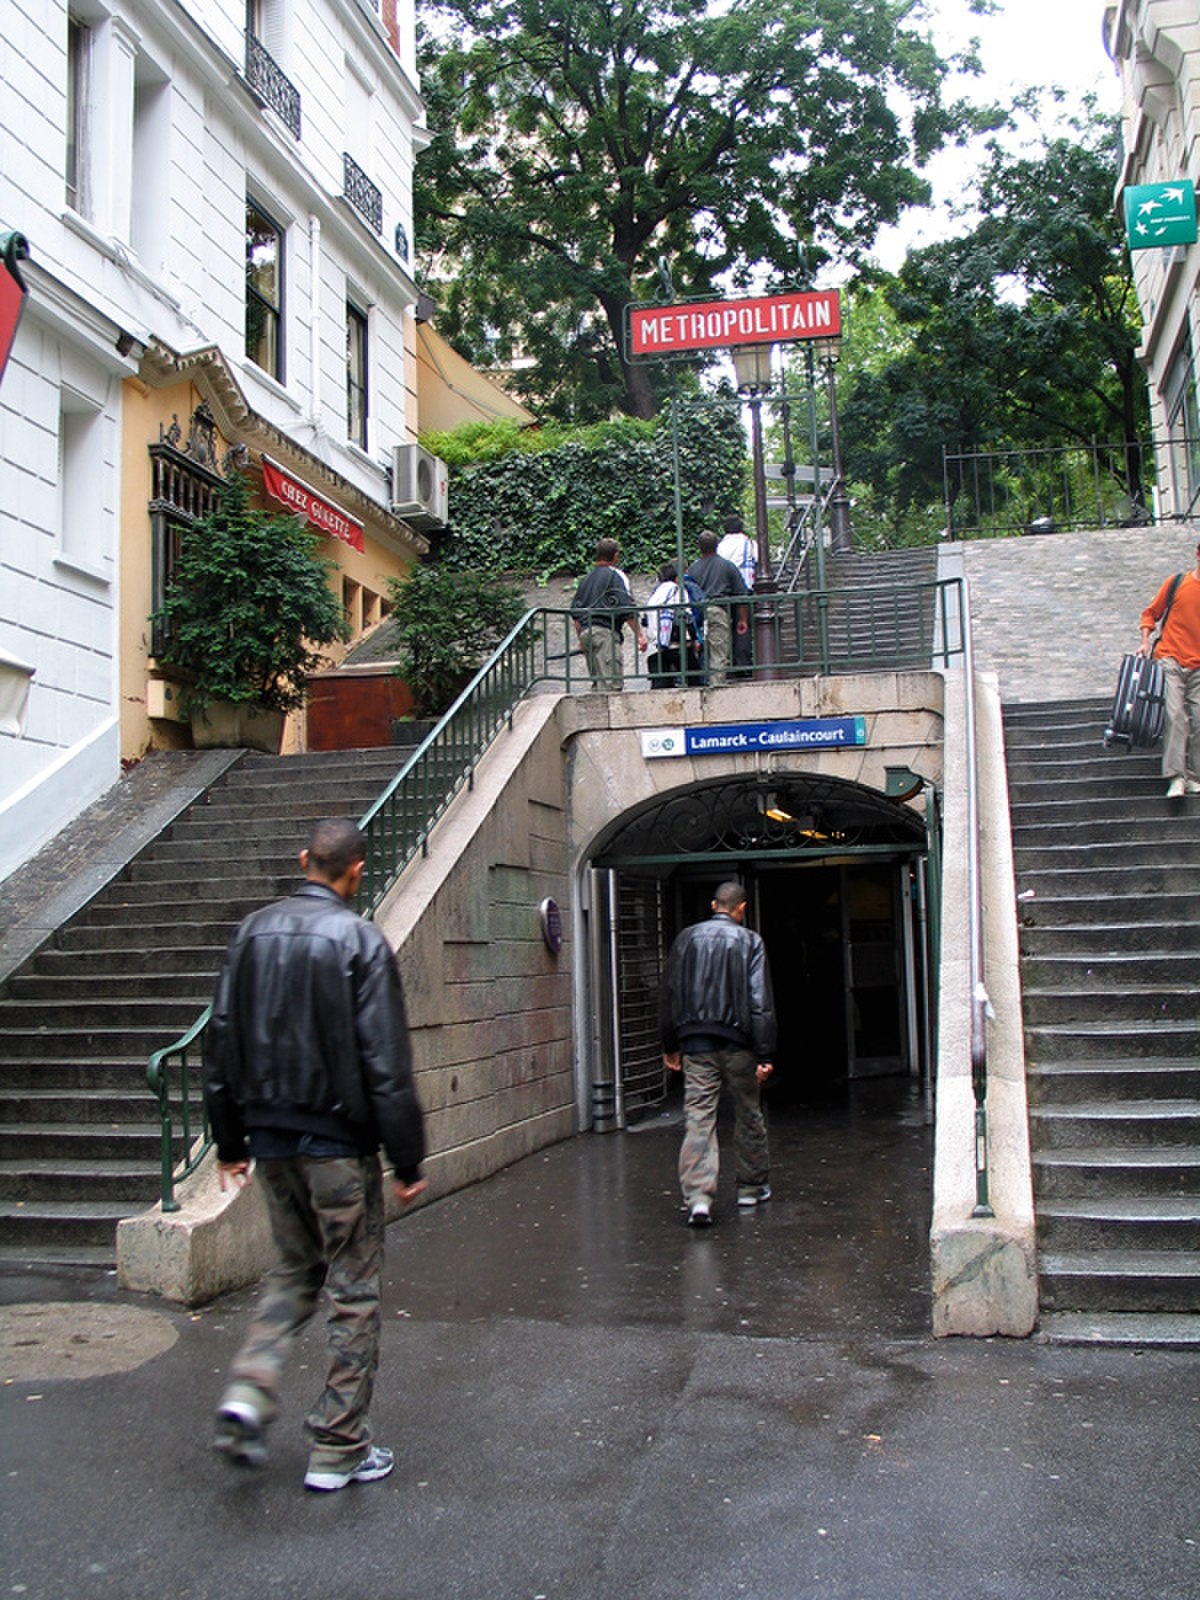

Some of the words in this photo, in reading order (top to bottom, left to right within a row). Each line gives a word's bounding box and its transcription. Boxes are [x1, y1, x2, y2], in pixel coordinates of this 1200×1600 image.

[641, 300, 831, 345] METROPOLITAIN
[281, 481, 308, 509] CHEZ
[691, 736, 747, 750] Lamarck
[758, 728, 845, 745] Caulaincourt
